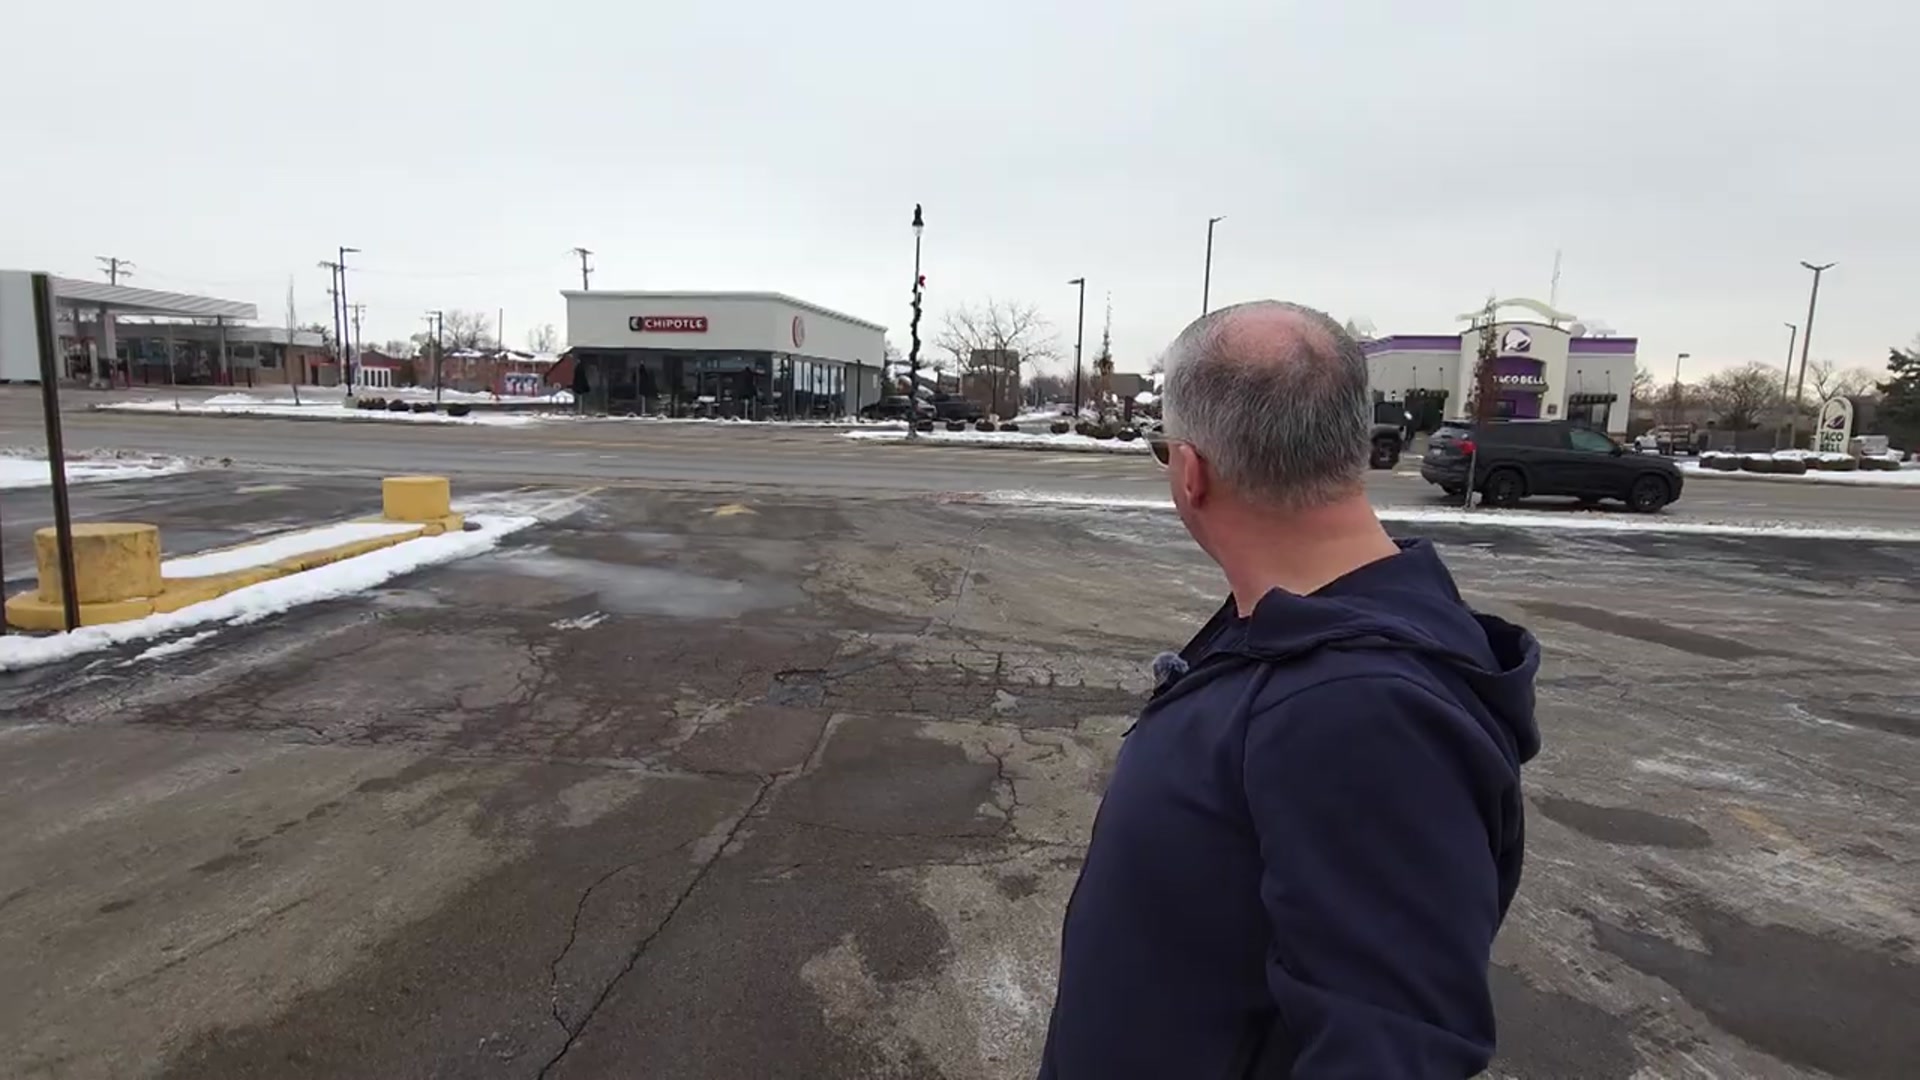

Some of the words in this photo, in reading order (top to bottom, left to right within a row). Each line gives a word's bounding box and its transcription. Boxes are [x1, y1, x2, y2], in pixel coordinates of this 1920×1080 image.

[644, 318, 704, 329] CHIPOTLE
[1492, 375, 1519, 384] TACO
[1520, 375, 1544, 384] BELL
[1820, 432, 1844, 442] TACO
